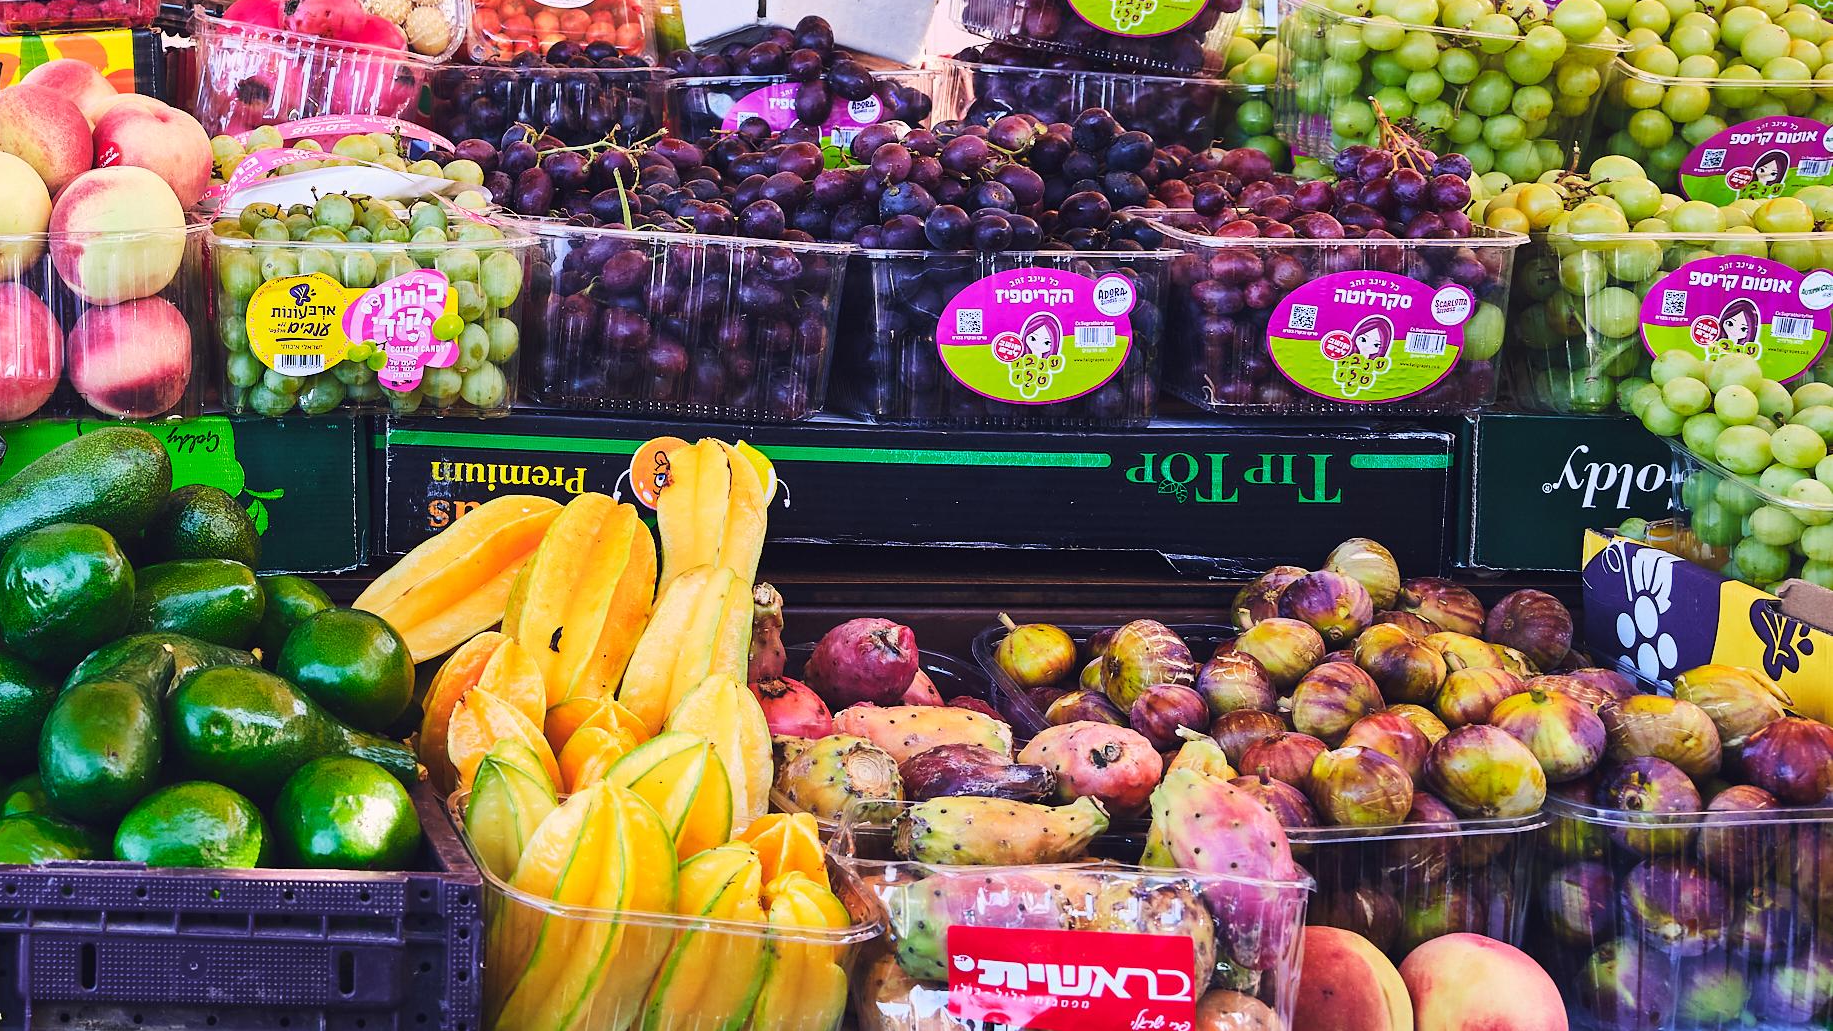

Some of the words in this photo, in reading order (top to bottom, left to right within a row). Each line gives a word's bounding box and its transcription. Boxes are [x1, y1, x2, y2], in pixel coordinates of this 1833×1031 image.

[1729, 132, 1774, 146] קריספ
[1775, 130, 1819, 144] אוטום
[1688, 270, 1740, 292] קריספ
[1740, 275, 1794, 295] אוטום
[995, 288, 1075, 307] הקריספיז
[1098, 287, 1129, 301] ADORA
[1333, 288, 1413, 311] סקרלוטה
[390, 345, 419, 353] COTTON
[167, 427, 219, 454] Goldy
[431, 461, 588, 494] Premium
[977, 959, 1193, 1002] בראשית
